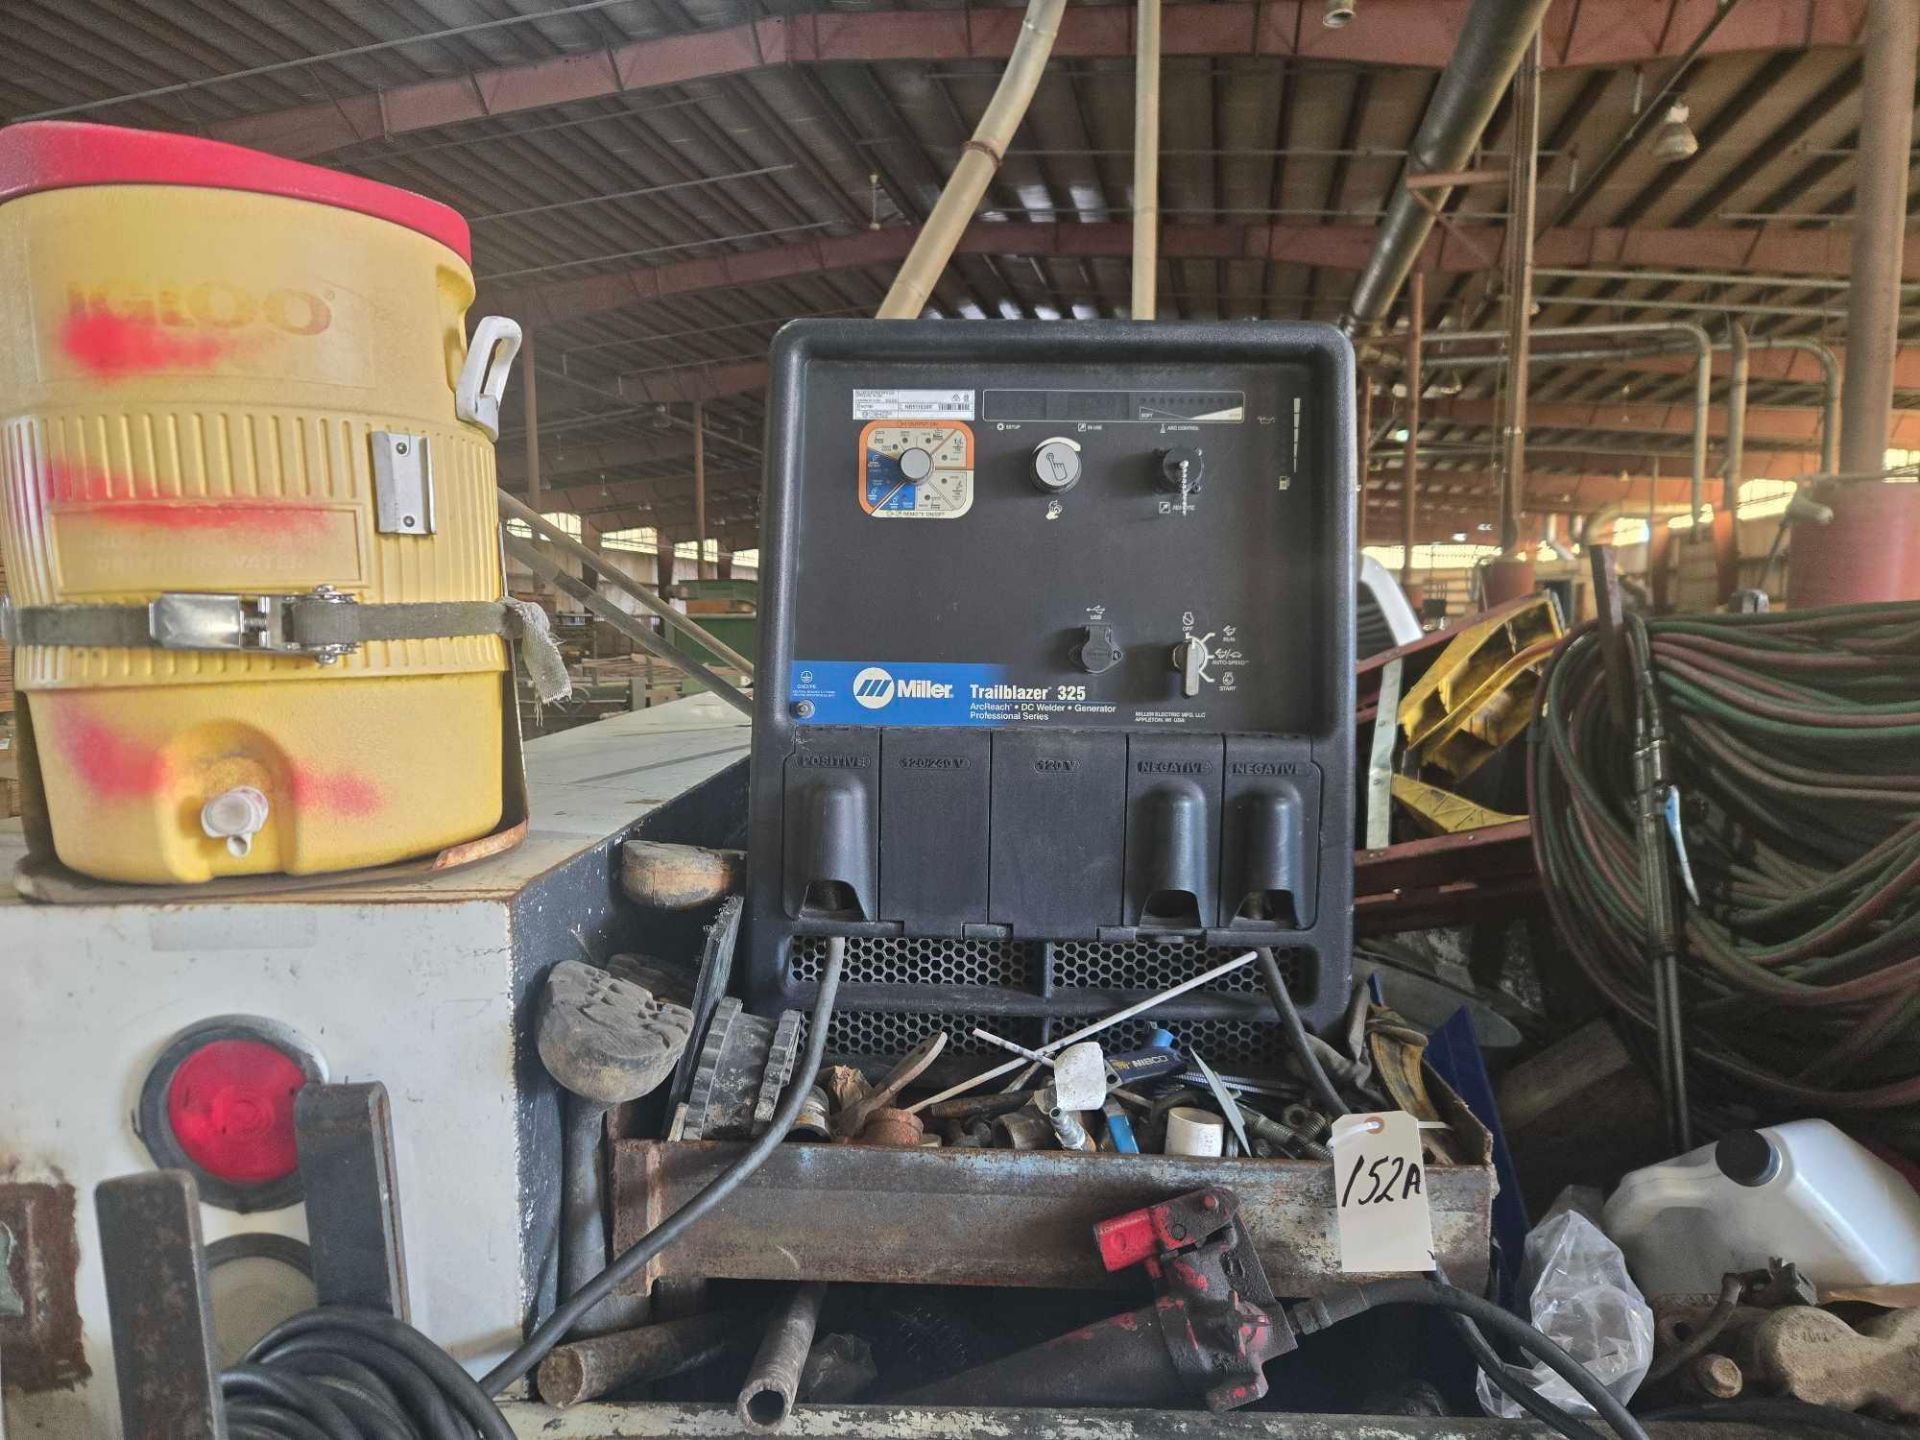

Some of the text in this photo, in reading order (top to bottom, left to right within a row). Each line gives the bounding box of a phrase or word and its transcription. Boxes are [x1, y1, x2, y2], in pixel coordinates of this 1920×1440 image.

[897, 679, 952, 698] Miller
[970, 684, 1086, 701] Trailblazer 325
[1036, 704, 1065, 712] Welder
[1074, 705, 1117, 713] Generator
[970, 712, 1049, 721] Professional Series
[802, 754, 866, 768] POSITIVE
[1132, 1055, 1170, 1068] NIBCO
[1341, 1154, 1421, 1208] 152A
